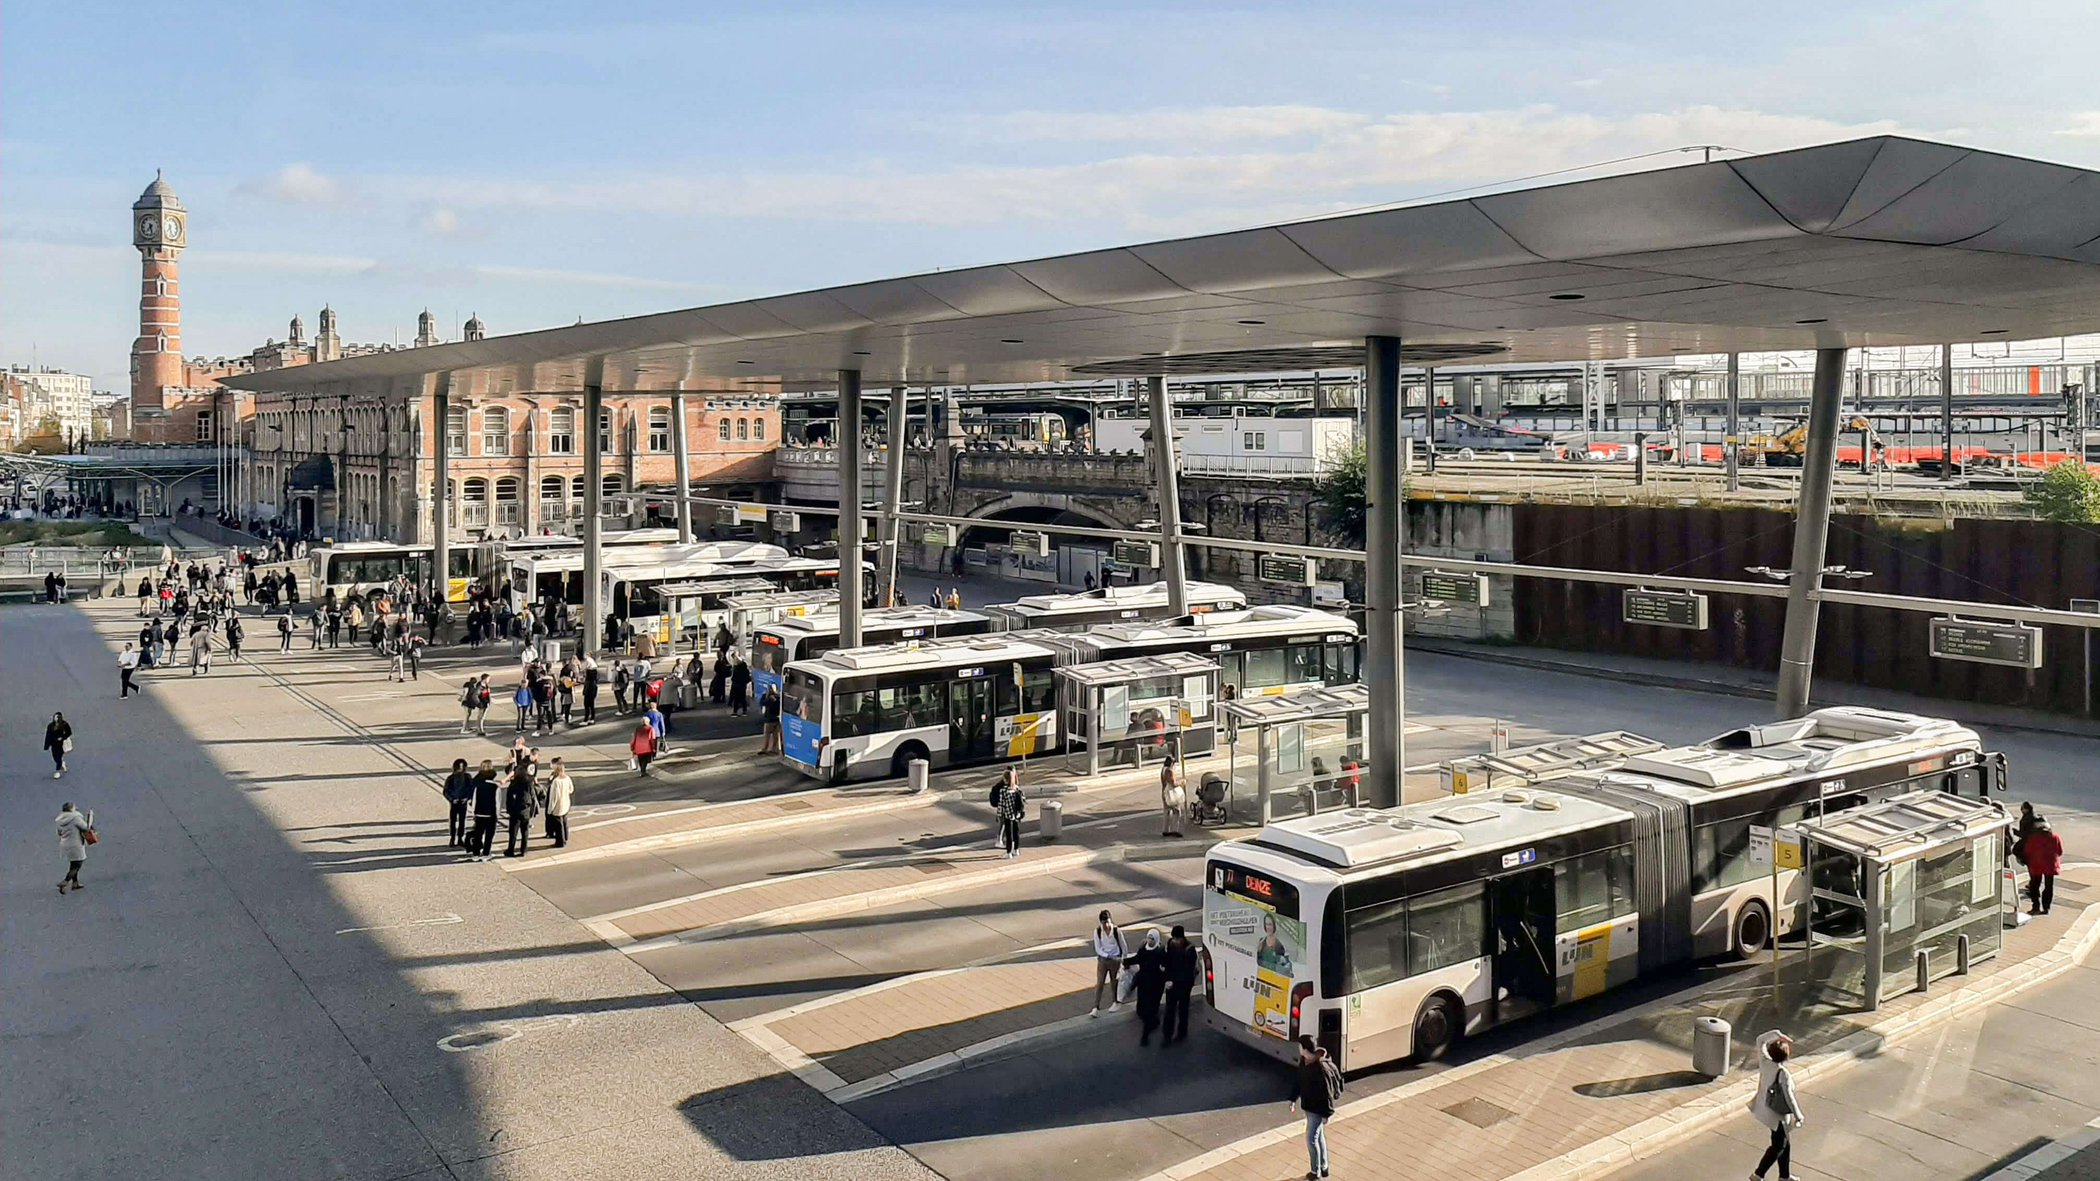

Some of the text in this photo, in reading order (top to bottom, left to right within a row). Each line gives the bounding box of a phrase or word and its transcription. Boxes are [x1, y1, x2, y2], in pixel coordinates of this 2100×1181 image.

[1784, 849, 1792, 860] 5
[1246, 875, 1272, 896] DEINZE
[1242, 976, 1271, 998] LIJN
